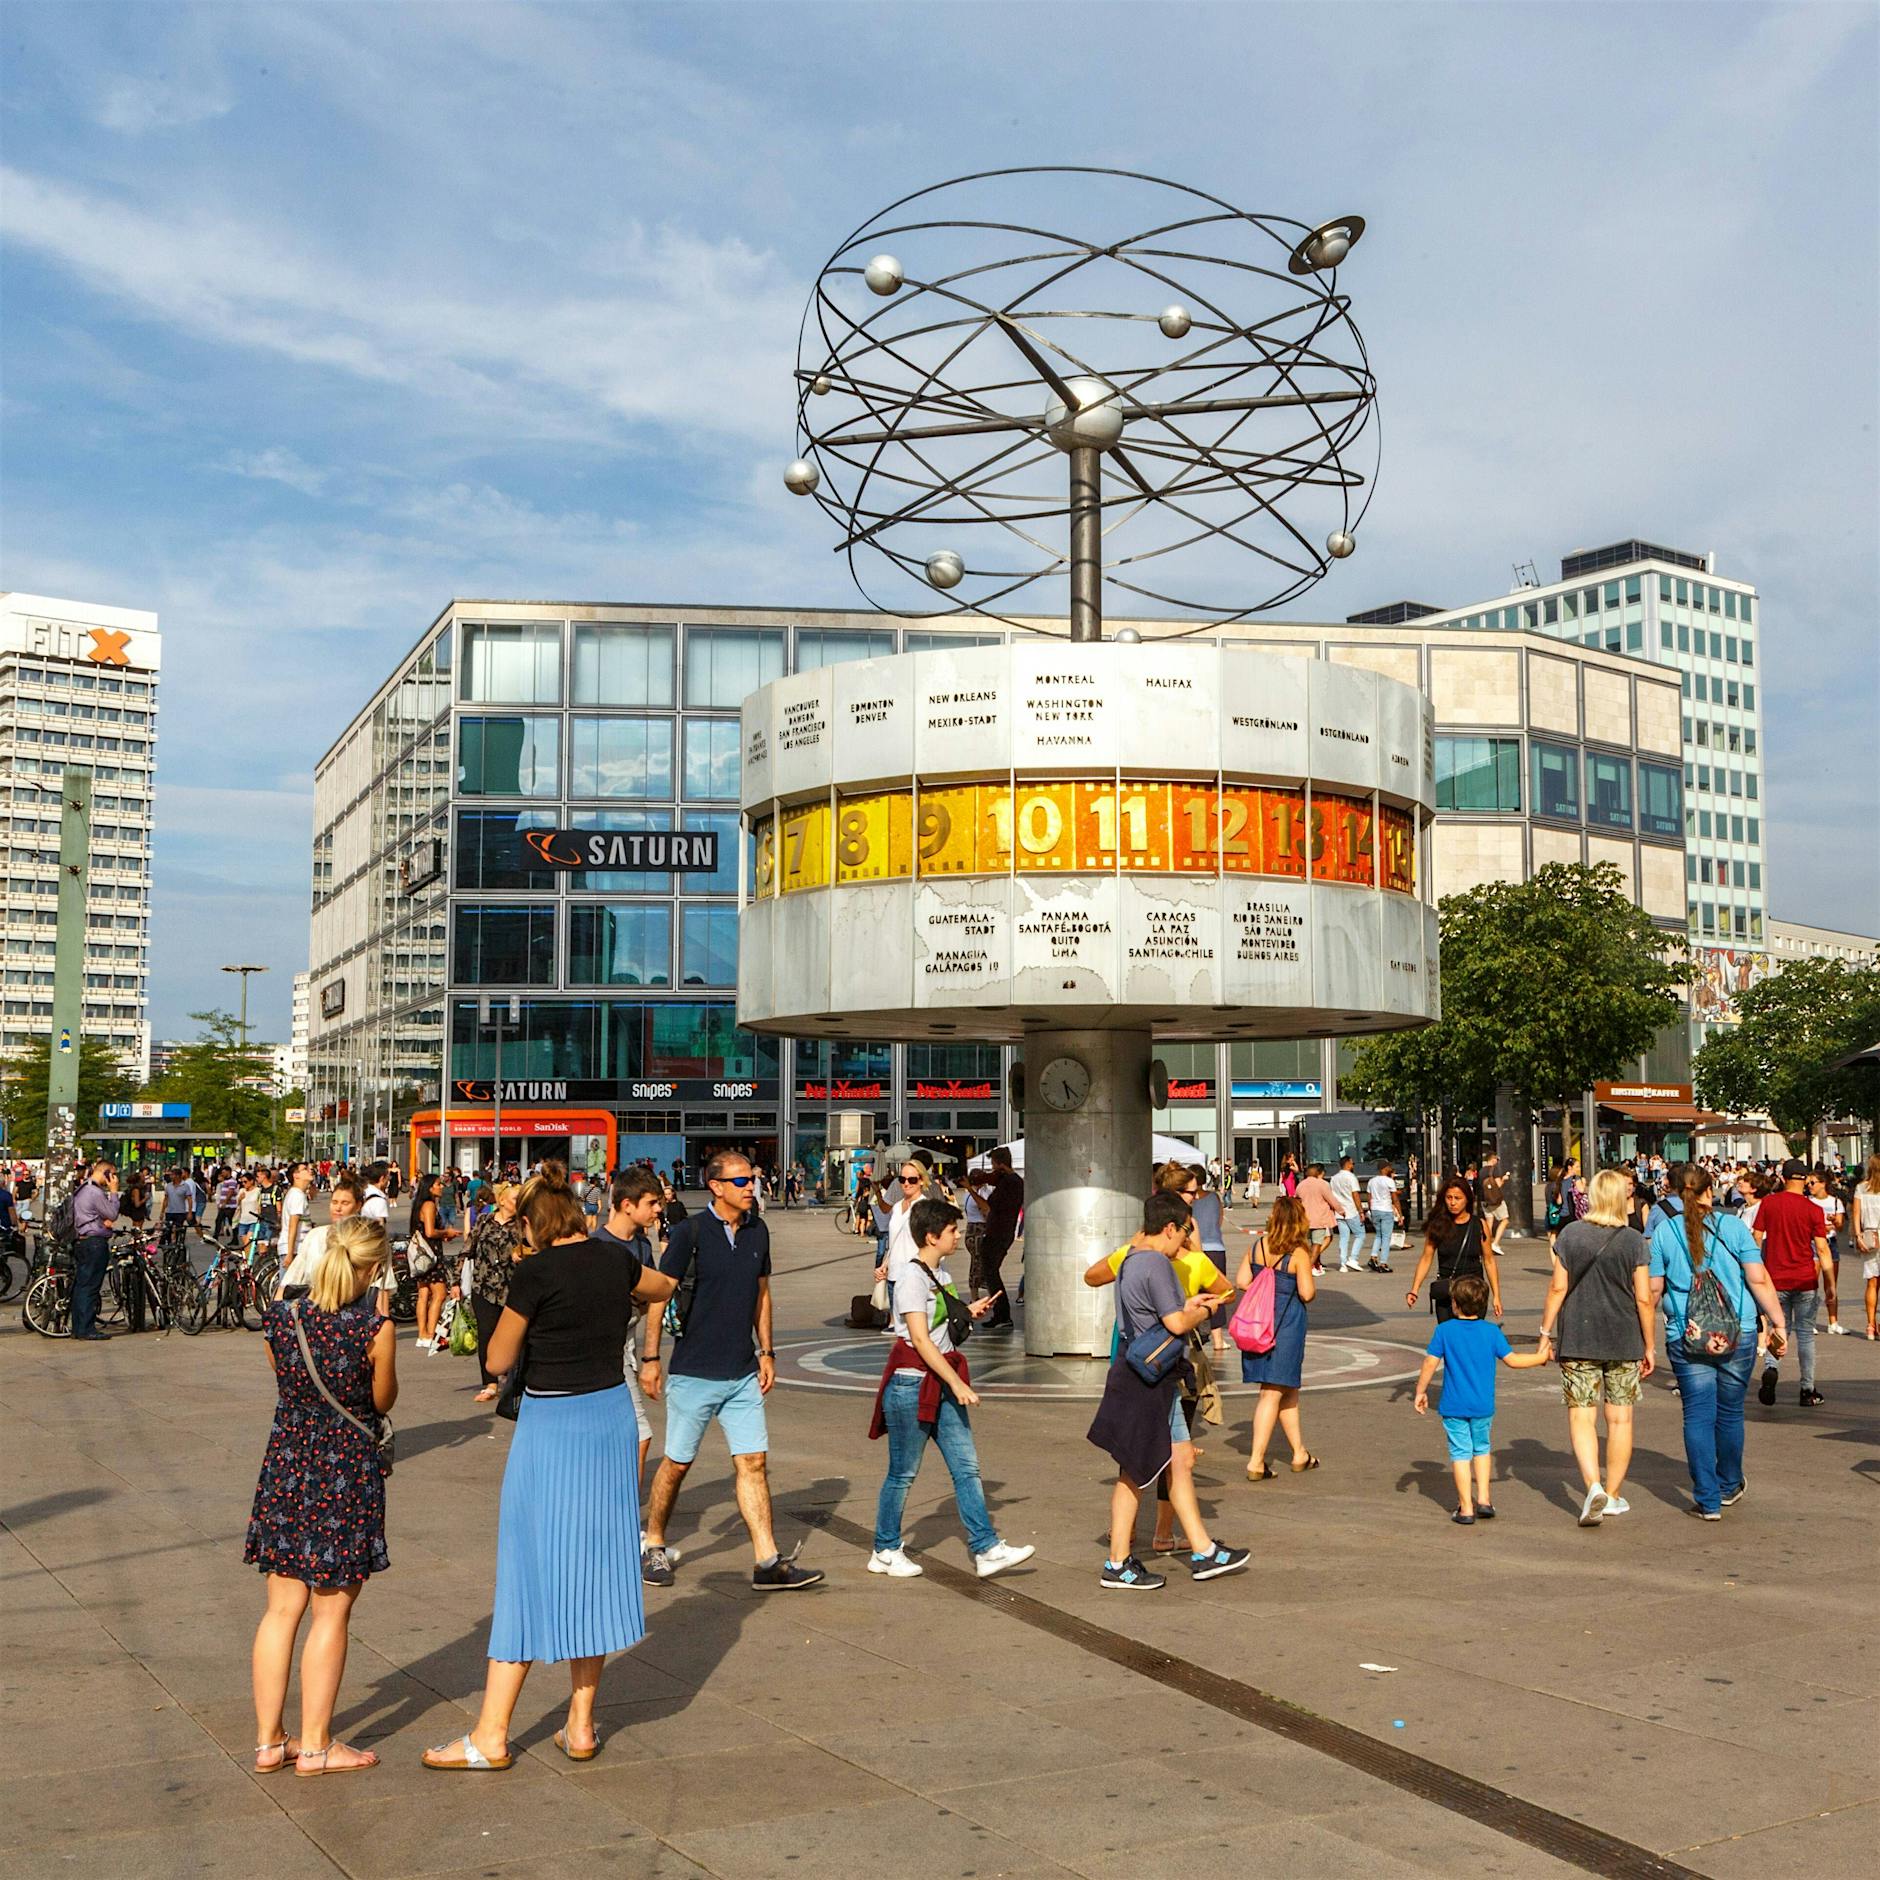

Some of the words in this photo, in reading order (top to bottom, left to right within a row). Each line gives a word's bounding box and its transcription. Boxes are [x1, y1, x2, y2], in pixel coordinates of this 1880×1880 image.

[1035, 675, 1095, 685] MONTREAL
[1146, 678, 1192, 688] HALIFAX
[929, 694, 950, 704] NEW
[953, 691, 997, 702] ORLEANS
[784, 699, 820, 715] VANCOUVER
[851, 699, 894, 713] EDMONTON
[1026, 699, 1103, 709] WASHINGTON
[856, 712, 887, 724] DENVER
[928, 715, 997, 728] MEXIKO-STADT
[1035, 712, 1060, 721] NEW
[1066, 712, 1094, 721] YORK
[1232, 716, 1298, 732] WESTGRÖNLAND
[779, 730, 790, 740] SAN
[792, 721, 825, 737] FRANCISCO
[1320, 727, 1369, 744] OSTGRÖNLAND
[783, 741, 793, 750] LOS
[795, 734, 820, 747] ANGELES
[1037, 736, 1092, 745] HAVANNA
[787, 818, 810, 875] 7
[840, 809, 869, 866] 8
[917, 802, 952, 859] 9
[987, 796, 1061, 855] 10
[1090, 796, 1147, 852] 11
[1184, 797, 1249, 854] 12
[1271, 803, 1325, 861] 13
[588, 835, 712, 866] SATURN
[1247, 902, 1290, 913] BRASILIA
[928, 913, 995, 925] GUATEMALA-
[1041, 912, 1089, 921] PANAMA
[1146, 912, 1196, 922] CARACAS
[1233, 913, 1247, 923] RIO
[1250, 913, 1260, 924] DE
[1264, 914, 1303, 925] JANEIRO
[964, 925, 995, 935] STADT
[1152, 924, 1165, 934] LA
[1171, 924, 1189, 934] PAZ
[1265, 926, 1292, 937] PAULO
[1051, 936, 1080, 945] QUITO
[1144, 935, 1198, 946] ASUNCIÓN
[1241, 938, 1296, 949] MONTEVIDEO
[936, 950, 988, 961] MANAGUA
[1052, 948, 1078, 958] LIMA
[1237, 950, 1271, 960] BUENOS
[1274, 951, 1299, 962] AIRES
[925, 961, 982, 974] GALÁPAGOS
[632, 1083, 673, 1100] snipes
[713, 1083, 753, 1100] snipes
[105, 1103, 117, 1116] U
